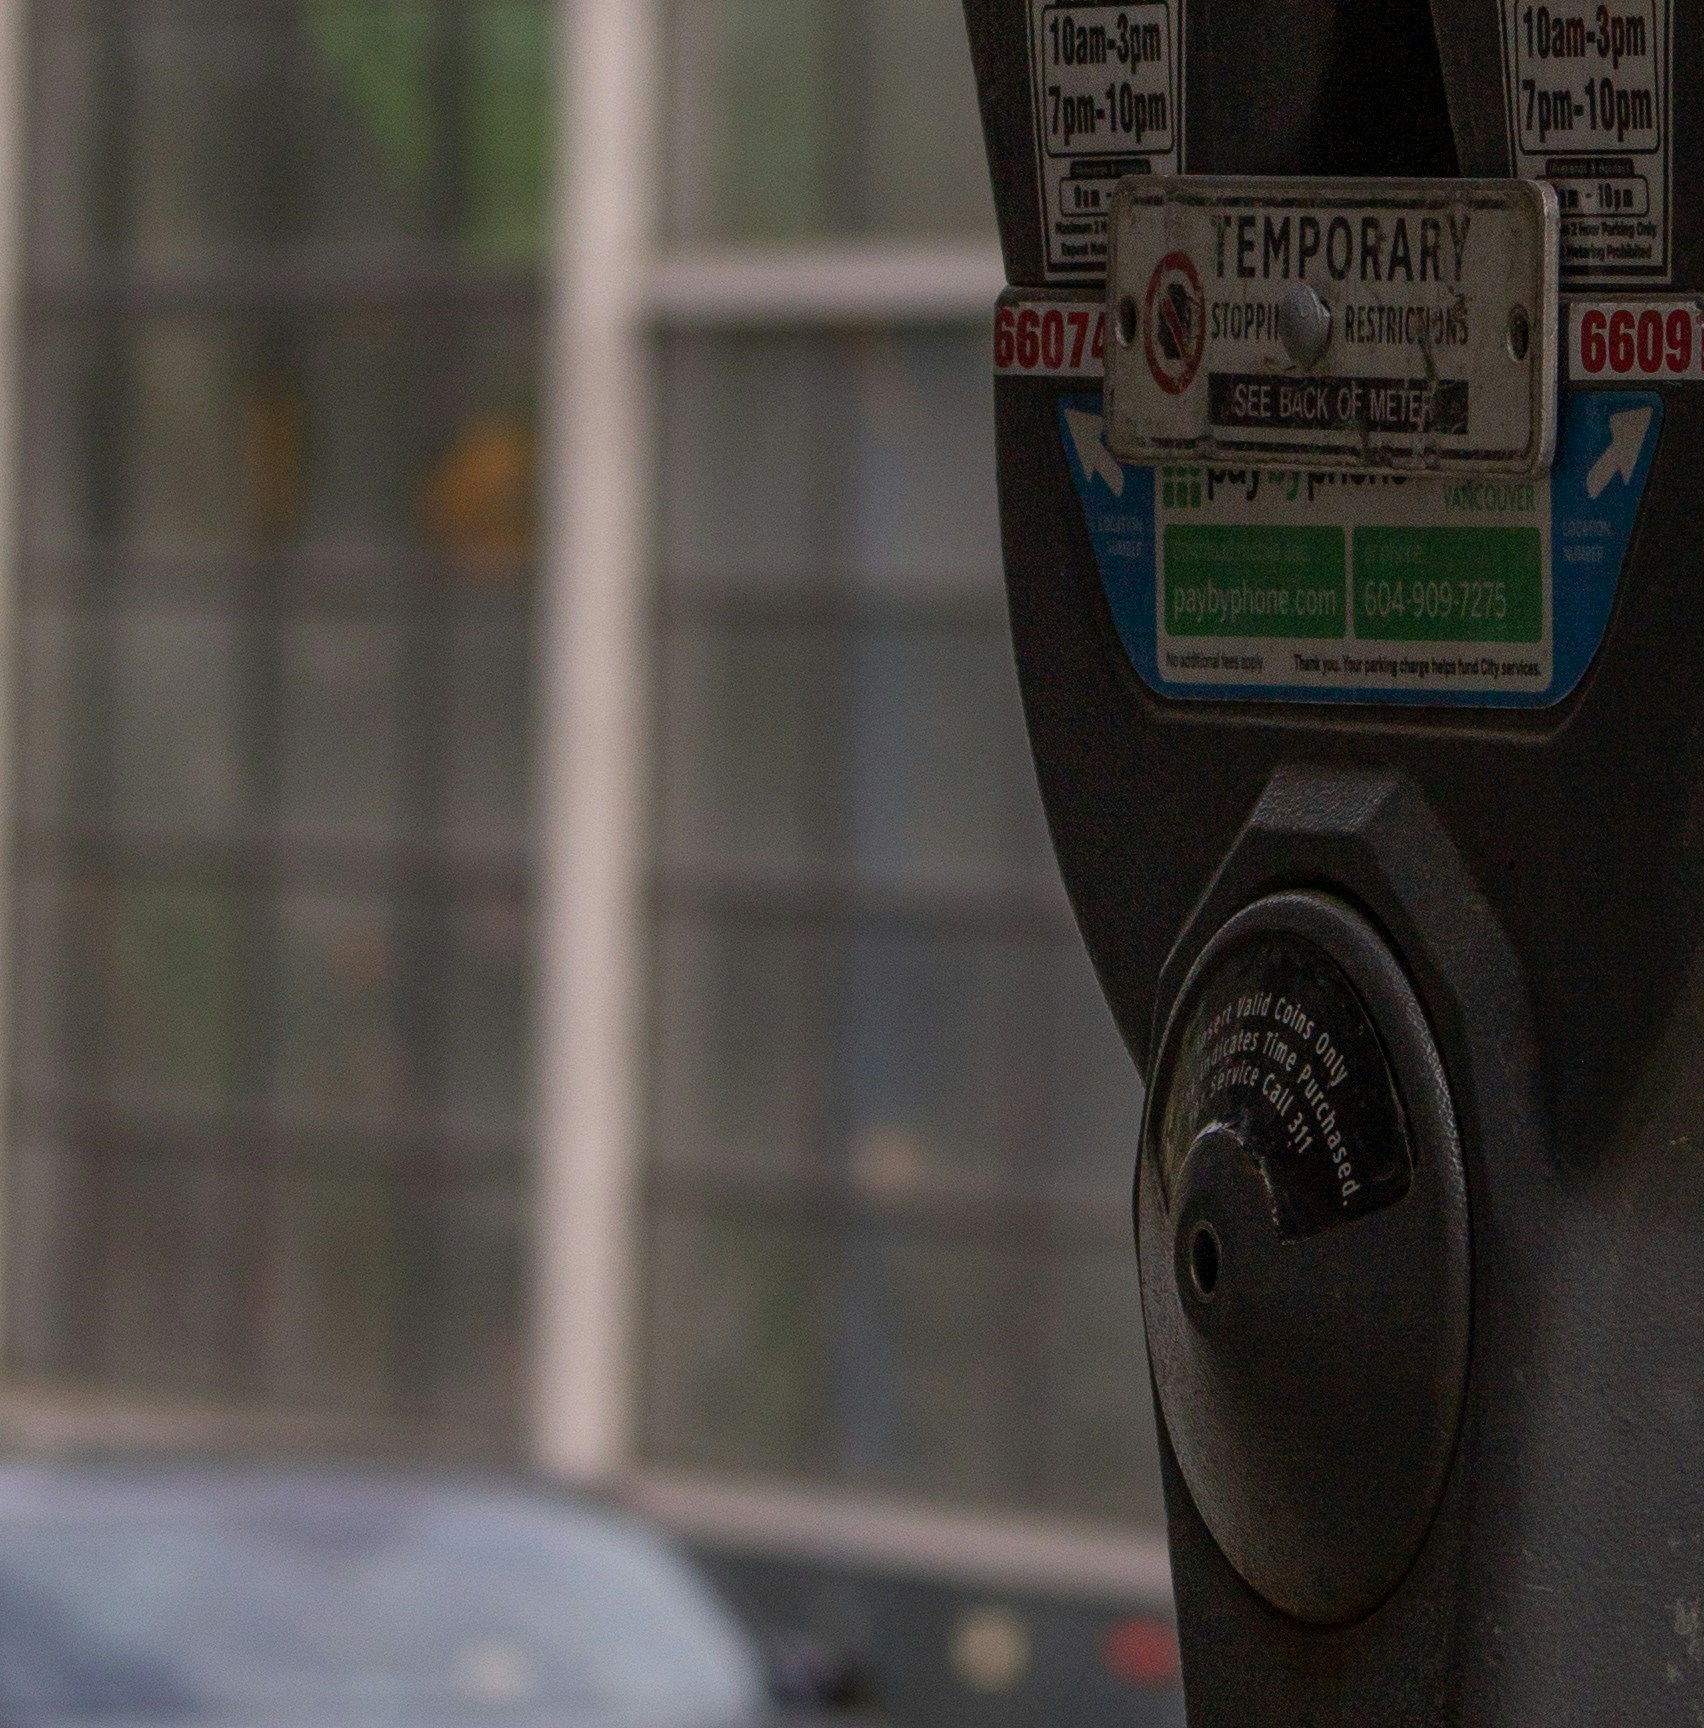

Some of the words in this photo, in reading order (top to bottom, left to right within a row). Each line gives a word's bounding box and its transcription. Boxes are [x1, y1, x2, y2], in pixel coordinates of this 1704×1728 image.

[1050, 13, 1162, 75] 10am-3pm
[1523, 4, 1646, 70] 10am-3pm
[1048, 80, 1167, 146] 7pm-10pm
[1521, 77, 1653, 144] 7pm-10pm
[1598, 182, 1634, 211] 10pm
[1210, 214, 1472, 283] TEMPORARY
[1601, 221, 1635, 240] Parking
[1637, 220, 1657, 240] Only
[1606, 243, 1652, 260] Prohibited
[1210, 300, 1281, 342] STOPPI
[1234, 383, 1271, 419] SEE
[1279, 384, 1329, 421] BACK
[1337, 385, 1361, 421] OF
[1369, 386, 1434, 426] METER
[1444, 482, 1536, 513] VANCOUVER
[1172, 578, 1336, 622] paybyphone.com
[1363, 580, 1508, 620] 604-909-7275
[1293, 652, 1320, 672] Thank
[1342, 654, 1363, 674] Your
[1364, 654, 1398, 679] parking
[1400, 655, 1430, 679] charge
[1431, 656, 1456, 680] helps
[1457, 656, 1480, 676] fund
[1480, 657, 1500, 680] City
[1500, 659, 1541, 678] services.
[1236, 991, 1273, 1019] Valid
[1274, 996, 1316, 1040] Coins
[1315, 1032, 1348, 1089] Only
[1262, 1072, 1295, 1118] Call
[1288, 1111, 1314, 1154] 311
[1262, 1030, 1297, 1073] Time
[1296, 1063, 1361, 1207] Purchased.
